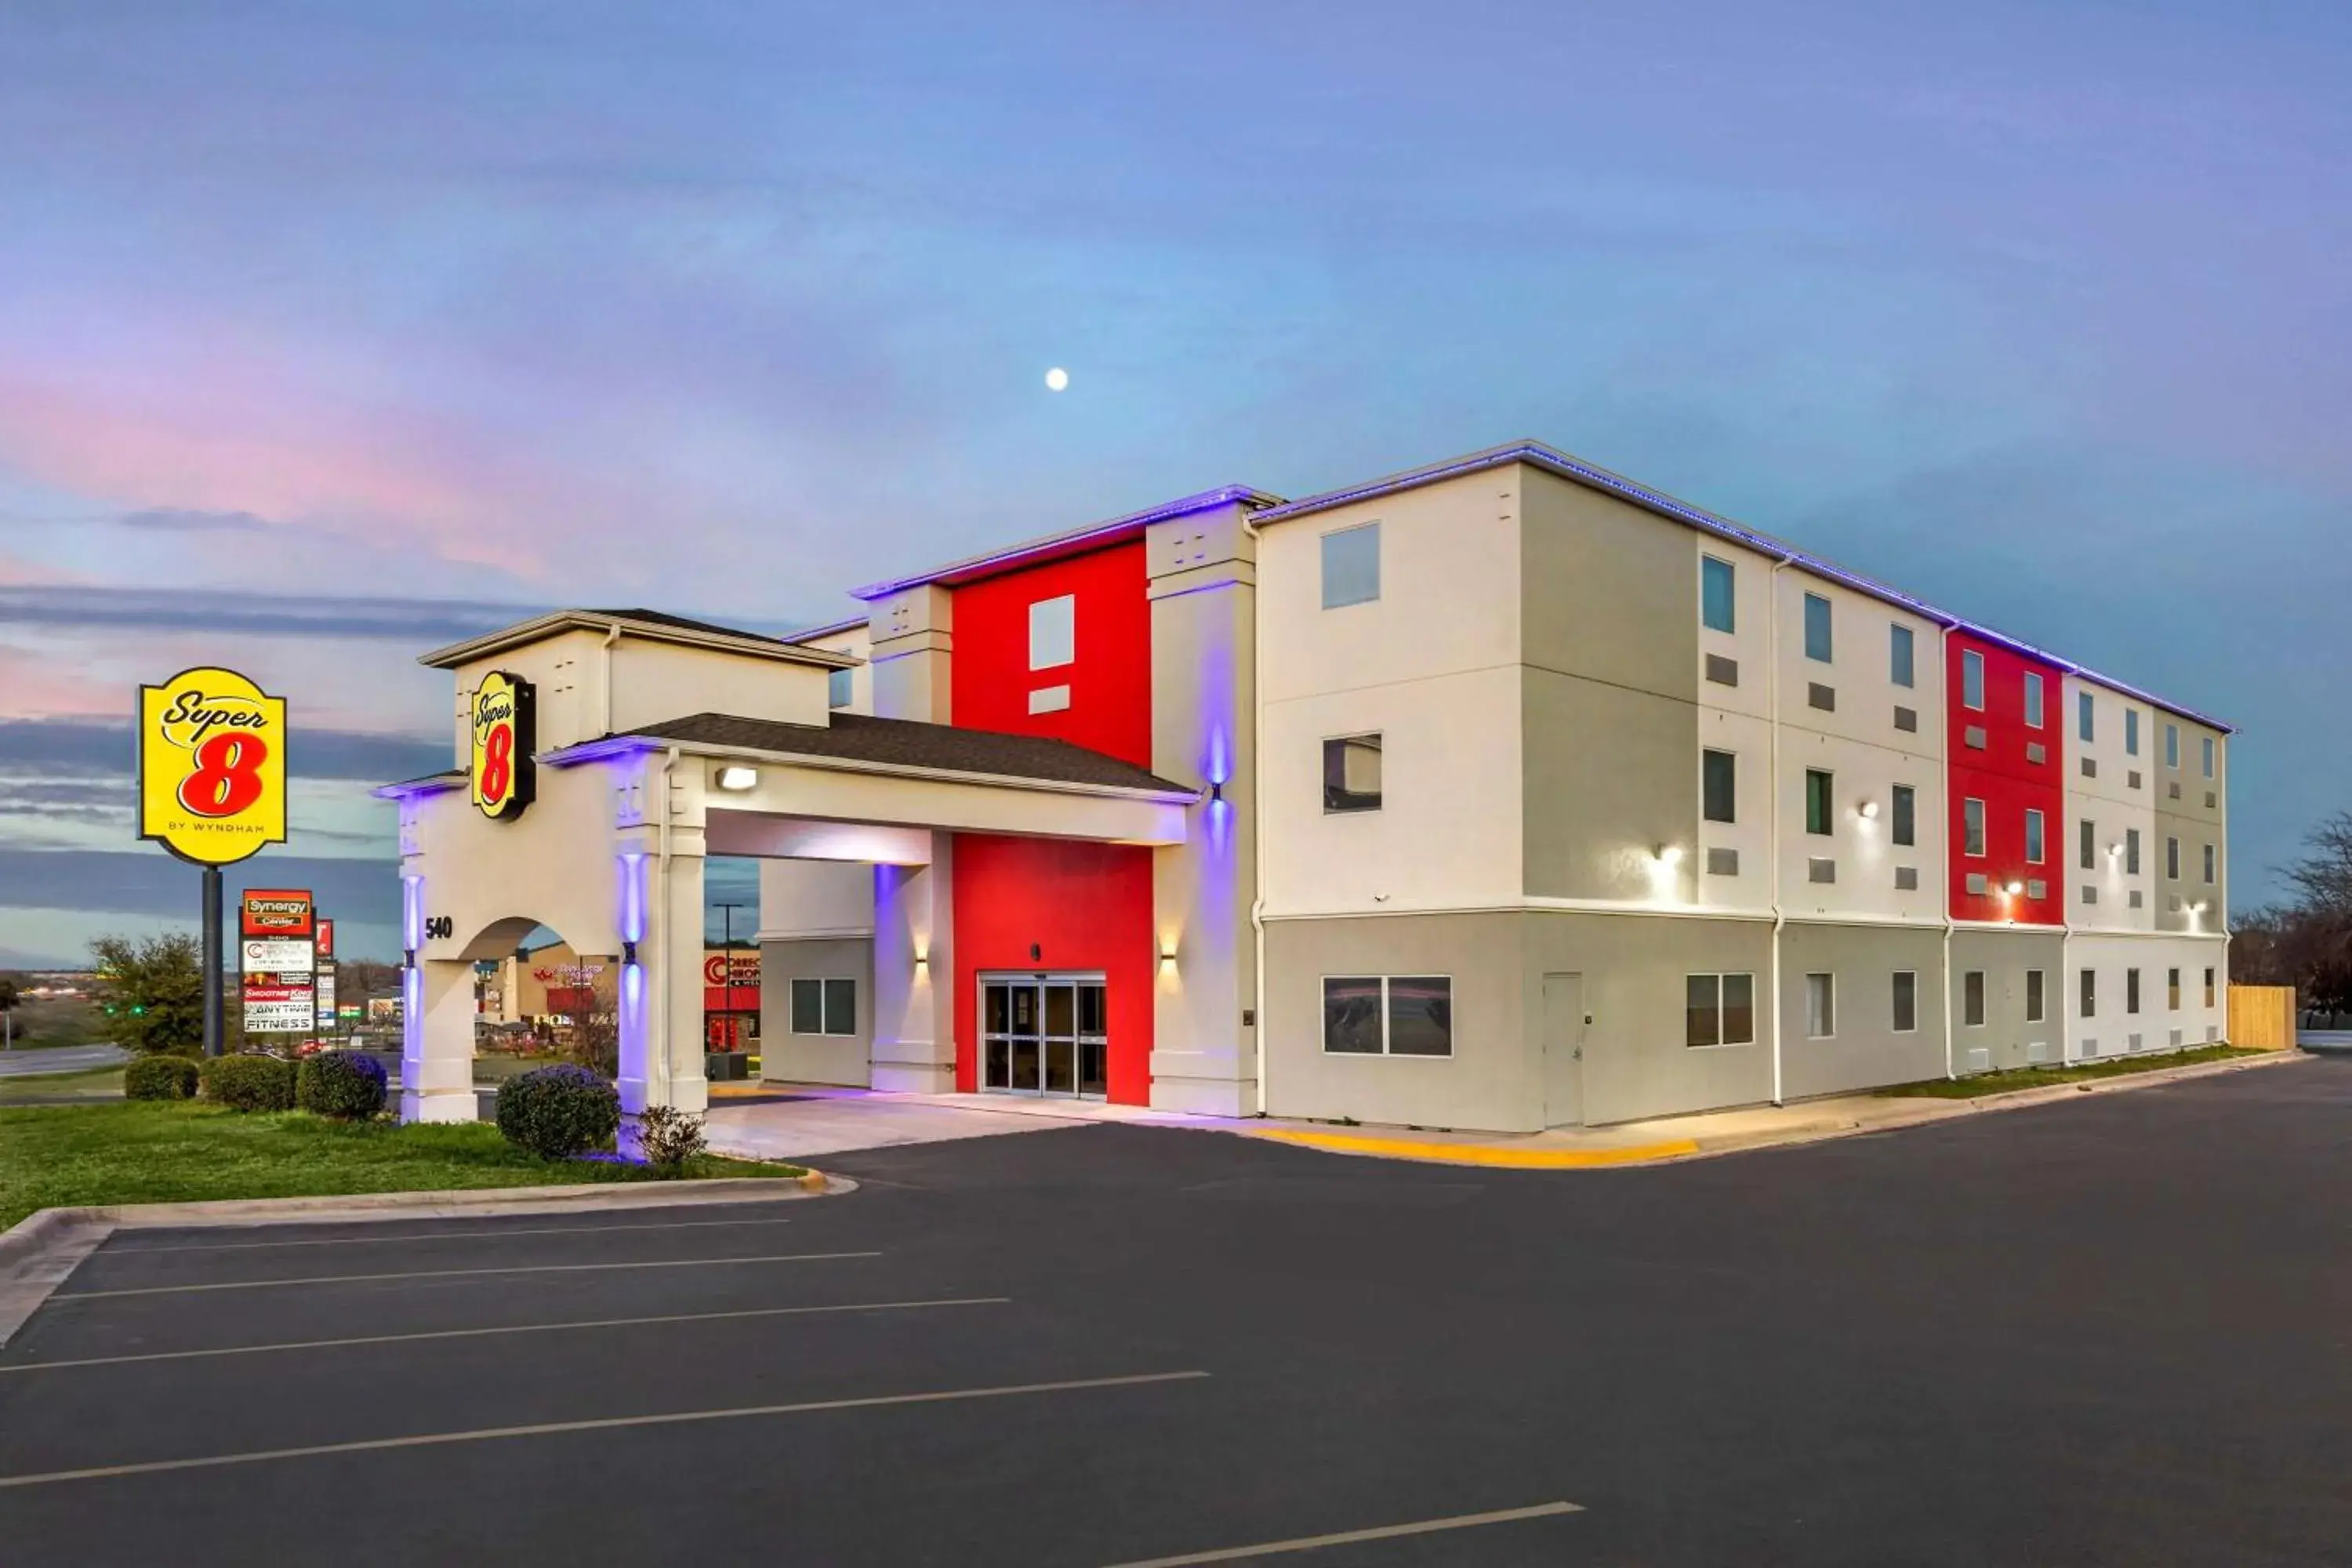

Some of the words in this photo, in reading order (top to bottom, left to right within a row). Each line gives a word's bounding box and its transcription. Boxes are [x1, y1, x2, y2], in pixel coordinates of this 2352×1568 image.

[162, 690, 269, 743] Super
[476, 693, 513, 742] Super
[176, 731, 268, 819] 8
[481, 723, 512, 806] 8
[169, 821, 186, 831] BY
[193, 822, 265, 833] WYNDHAM
[250, 901, 307, 913] Synergy
[260, 916, 295, 926] Center
[426, 916, 452, 940] 540
[248, 1018, 310, 1029] FITNESS
